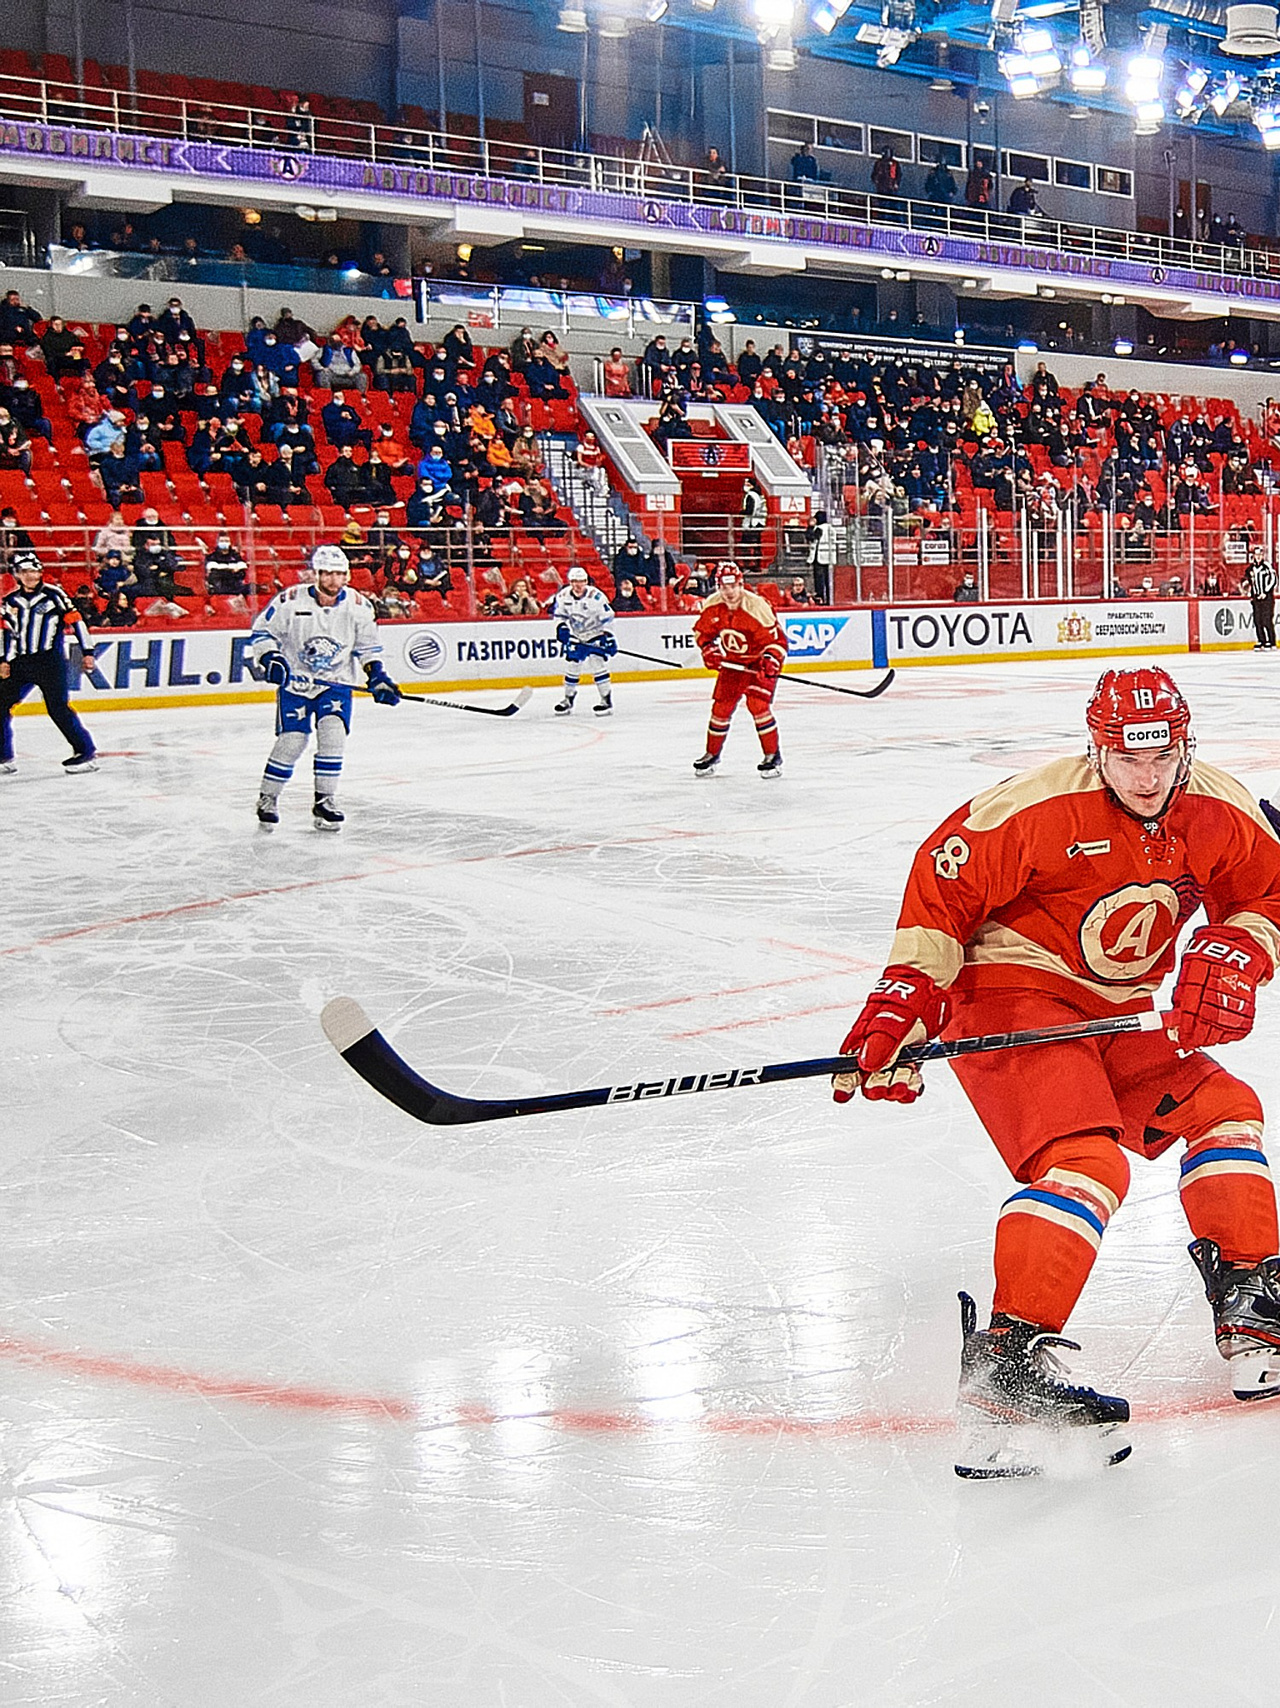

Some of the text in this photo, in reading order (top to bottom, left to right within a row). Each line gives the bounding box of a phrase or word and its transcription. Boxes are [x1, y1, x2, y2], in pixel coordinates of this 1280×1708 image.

[661, 634, 695, 649] THE
[787, 623, 836, 650] SAP
[889, 611, 1033, 650] TOYOTA
[1131, 688, 1154, 710] 18
[606, 1066, 764, 1104] BAUER
